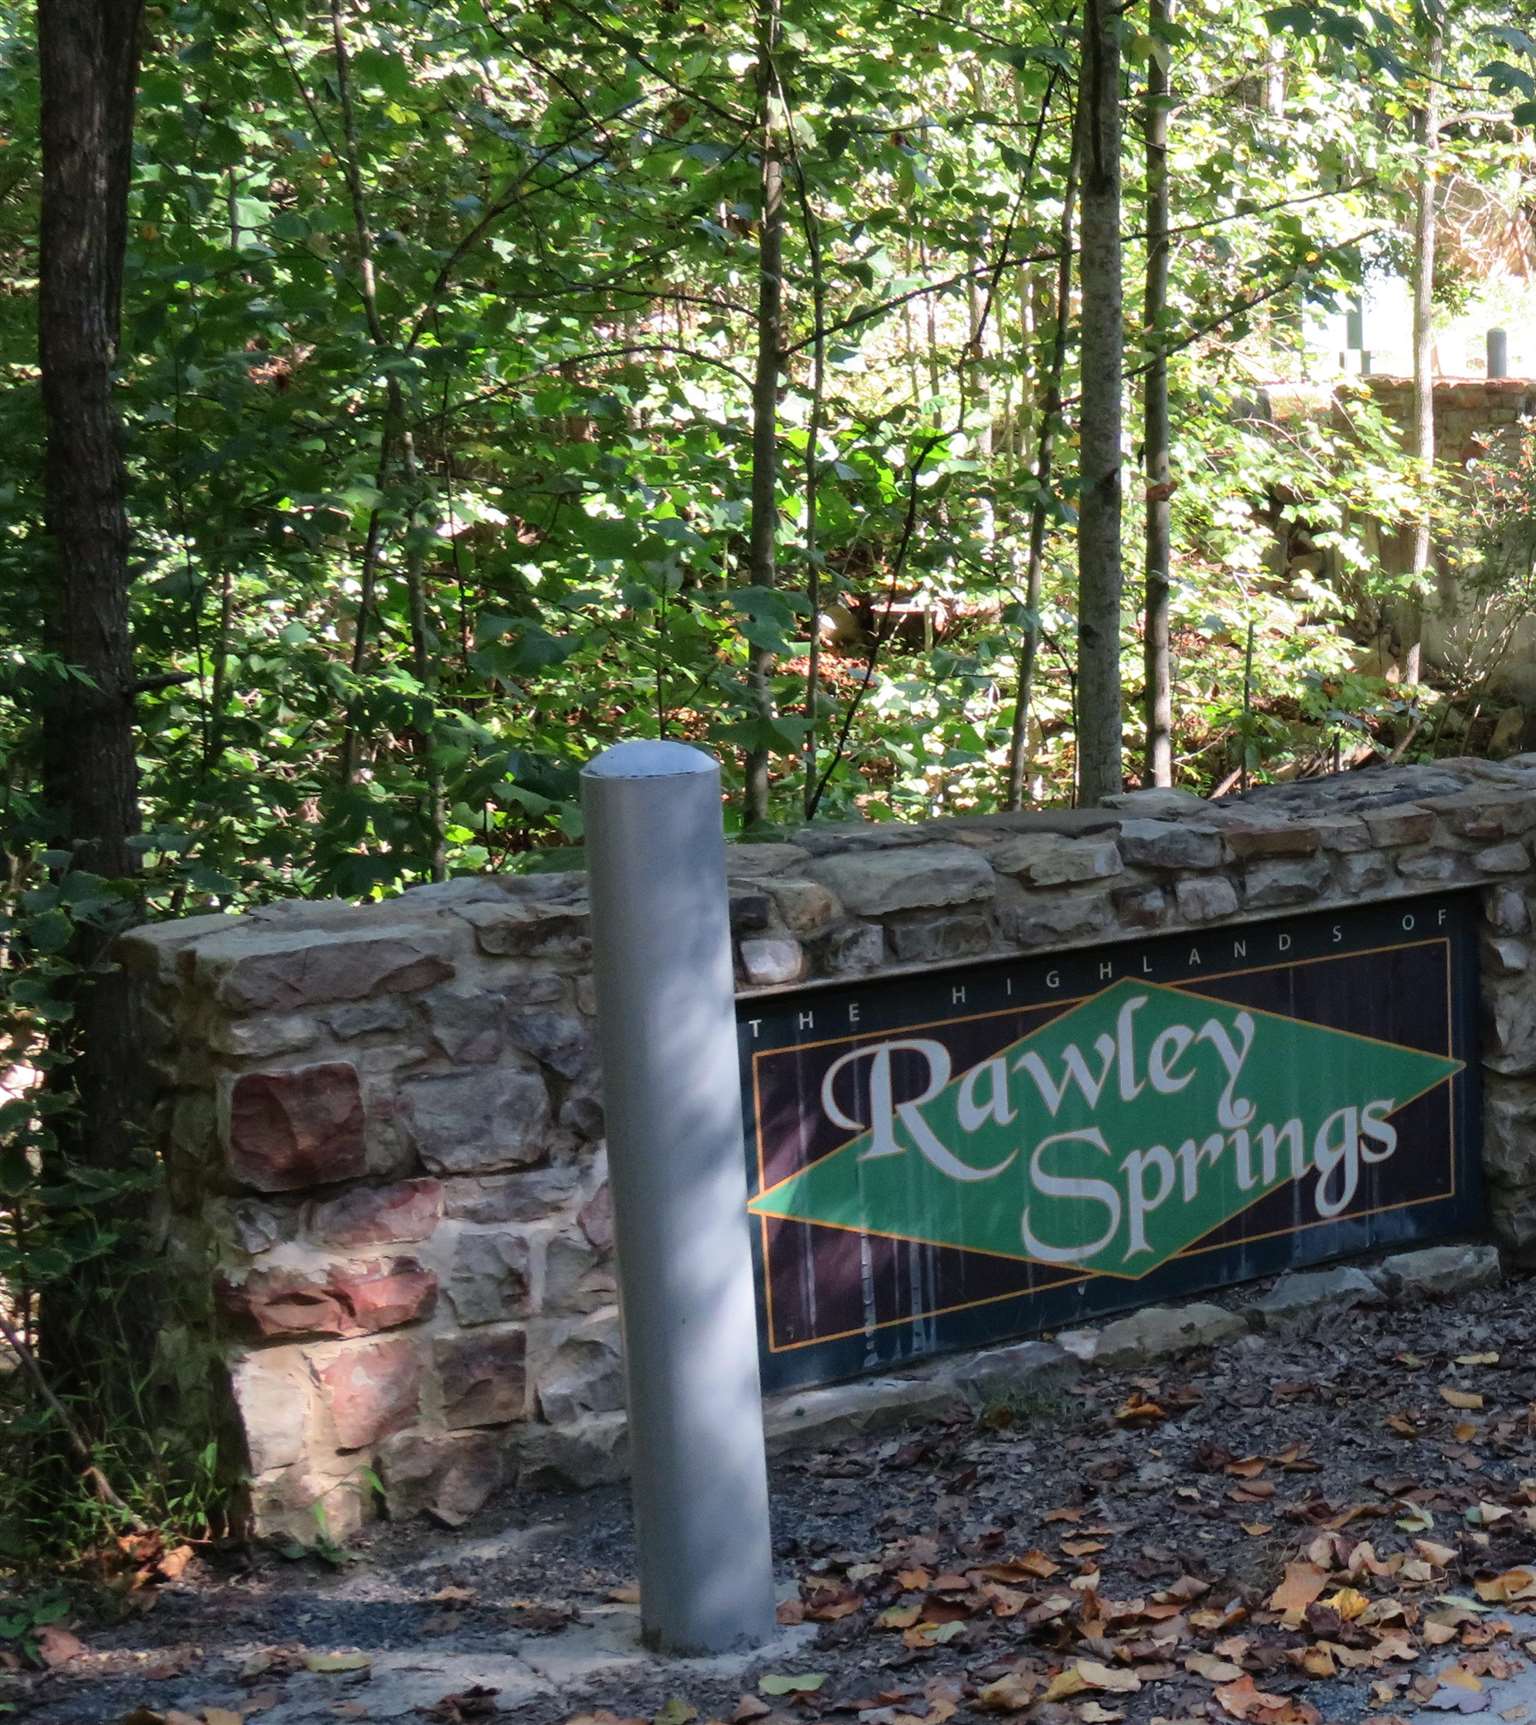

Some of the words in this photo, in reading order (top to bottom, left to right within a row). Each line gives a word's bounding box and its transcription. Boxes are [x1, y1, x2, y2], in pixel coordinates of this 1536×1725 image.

[748, 1003, 861, 1038] THE
[952, 925, 1343, 1004] HIGHLANDS
[1402, 909, 1448, 932] OF
[821, 996, 1257, 1182] Rawley
[1020, 1098, 1399, 1263] Springs
